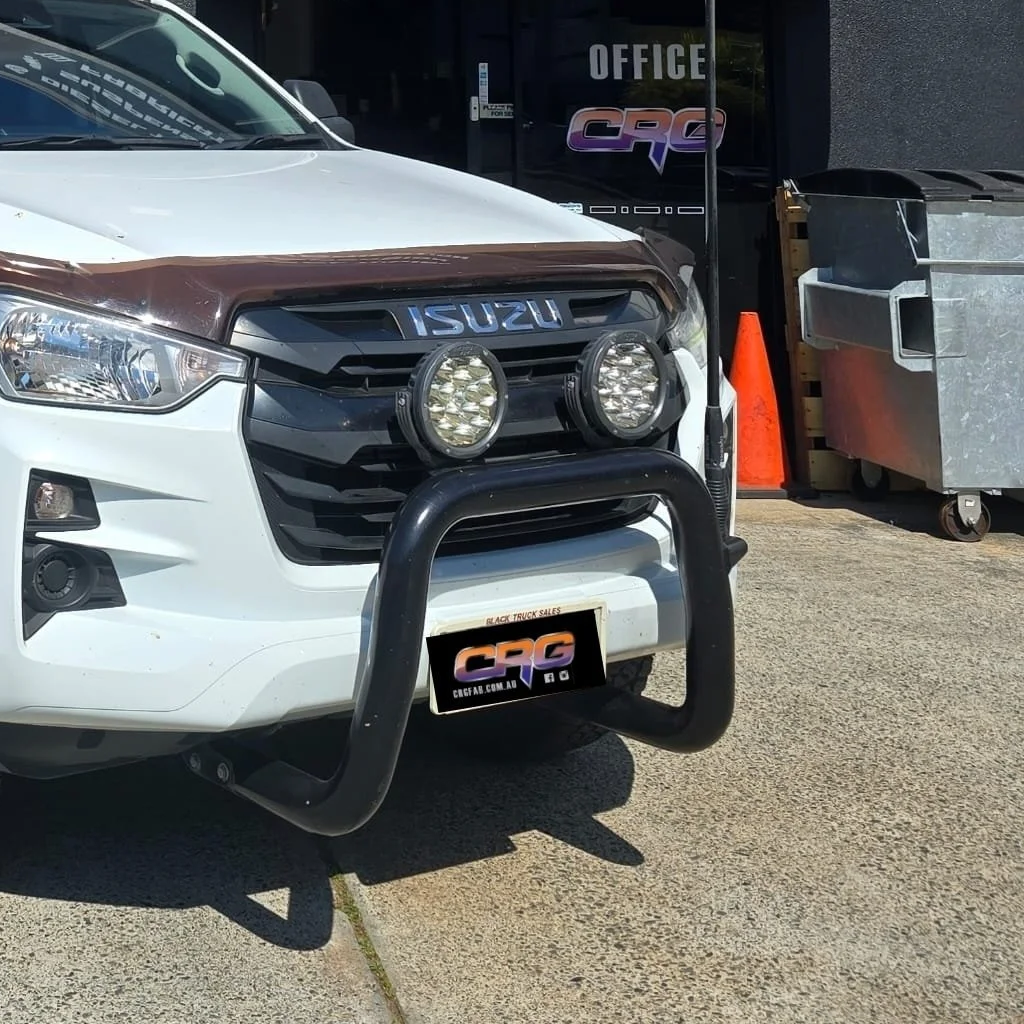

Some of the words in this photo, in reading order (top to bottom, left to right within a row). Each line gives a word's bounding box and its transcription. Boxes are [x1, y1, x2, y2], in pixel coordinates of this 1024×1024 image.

[589, 44, 706, 80] OFFICE
[566, 107, 727, 176] CRG
[407, 298, 564, 337] ISUZU
[485, 614, 510, 626] BLACK
[513, 610, 538, 623] TRUCK
[539, 606, 562, 618] SALES
